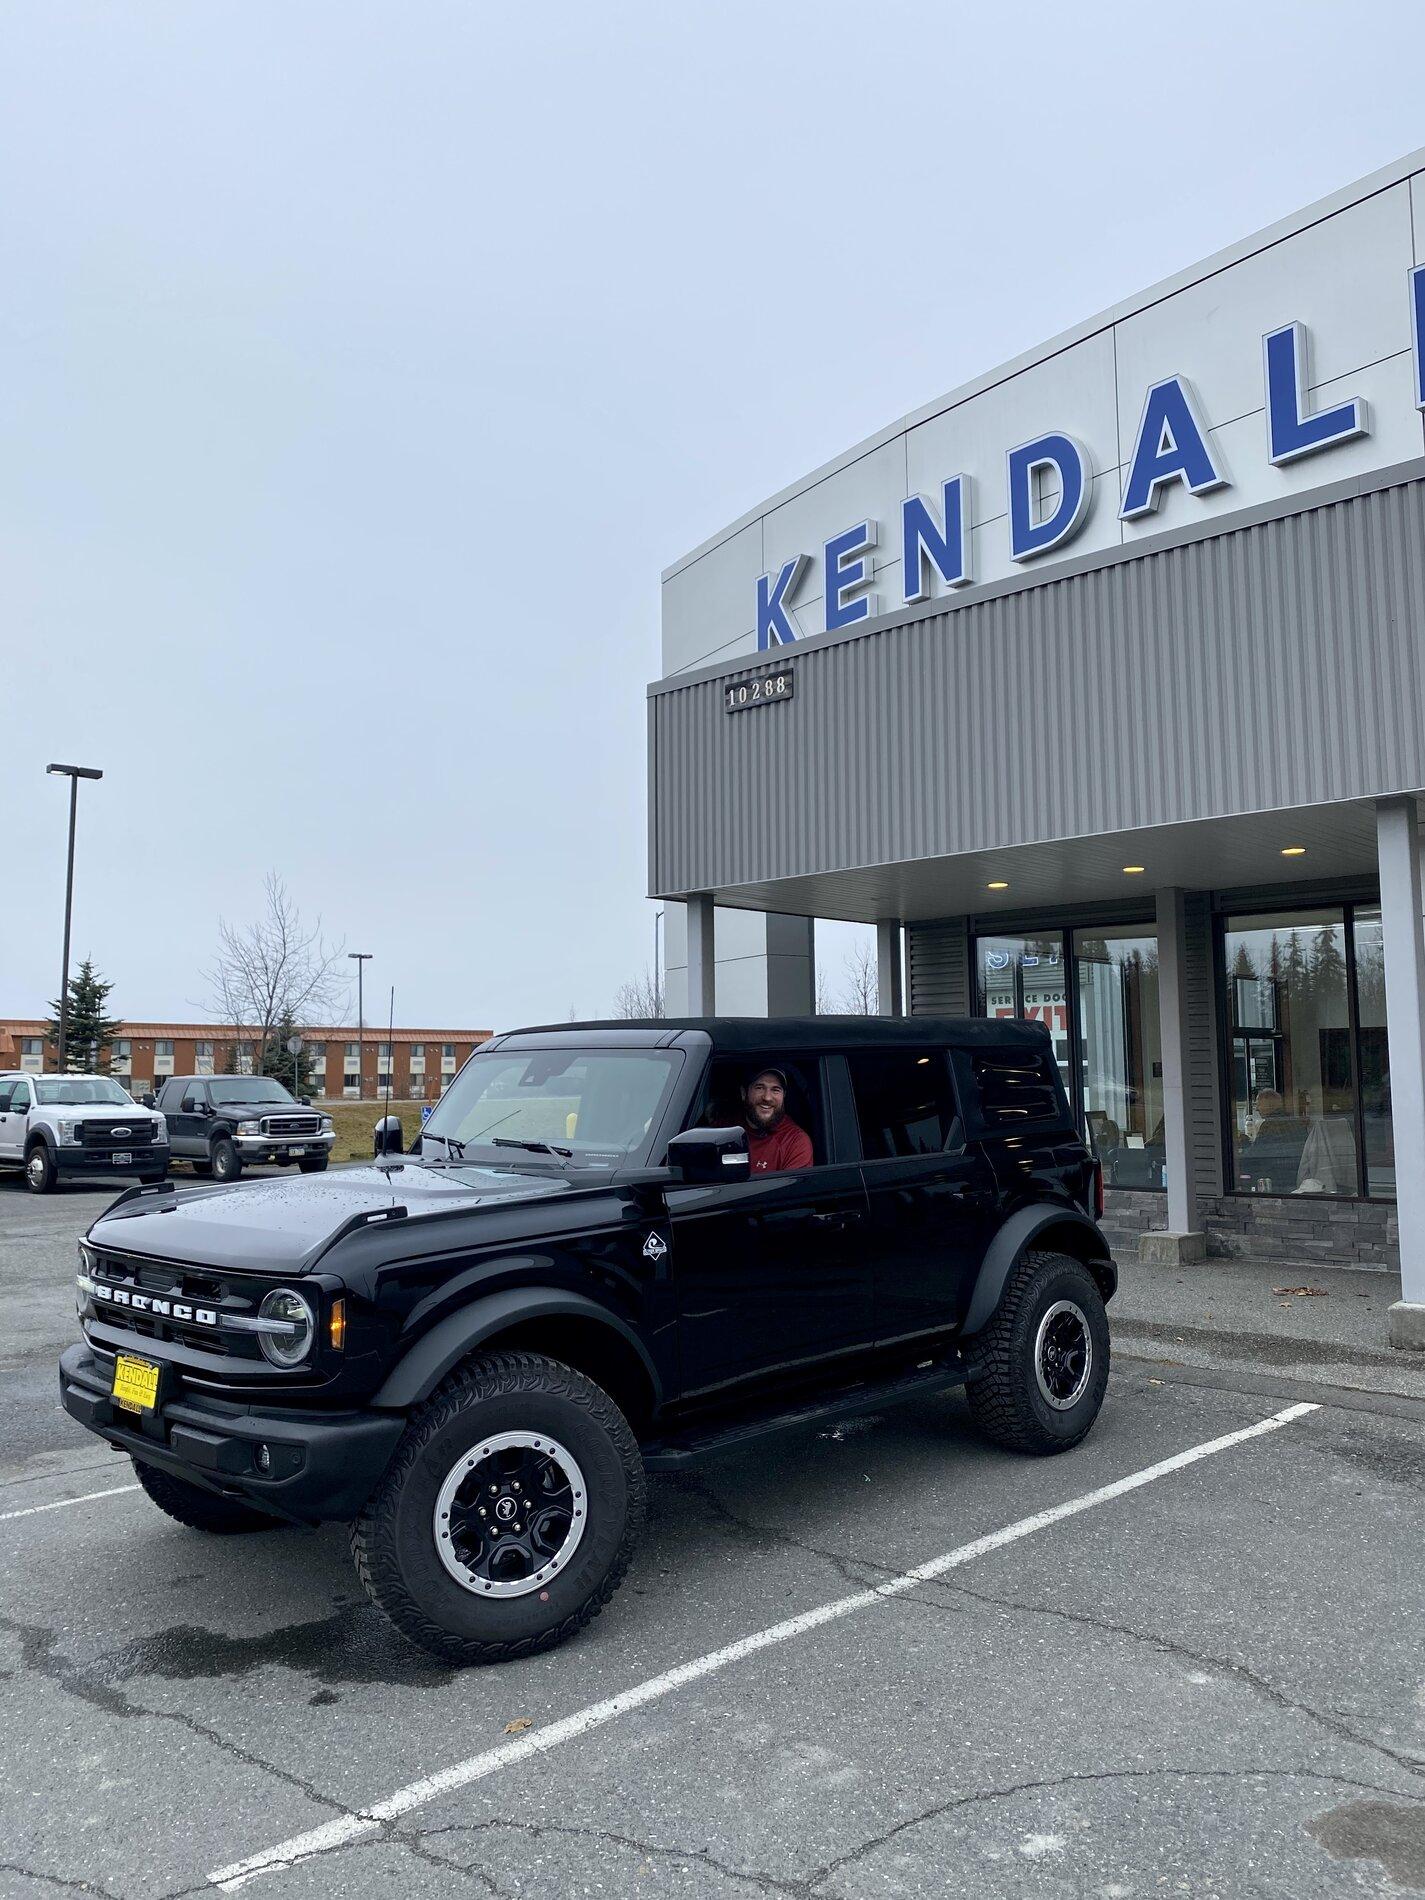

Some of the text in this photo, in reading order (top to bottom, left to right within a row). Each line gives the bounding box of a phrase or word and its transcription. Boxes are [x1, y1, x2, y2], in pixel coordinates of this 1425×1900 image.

[756, 262, 1425, 652] KENDAL
[729, 676, 786, 707] 10288
[991, 994, 1038, 1005] SERCE
[97, 1285, 216, 1325] BRONCO
